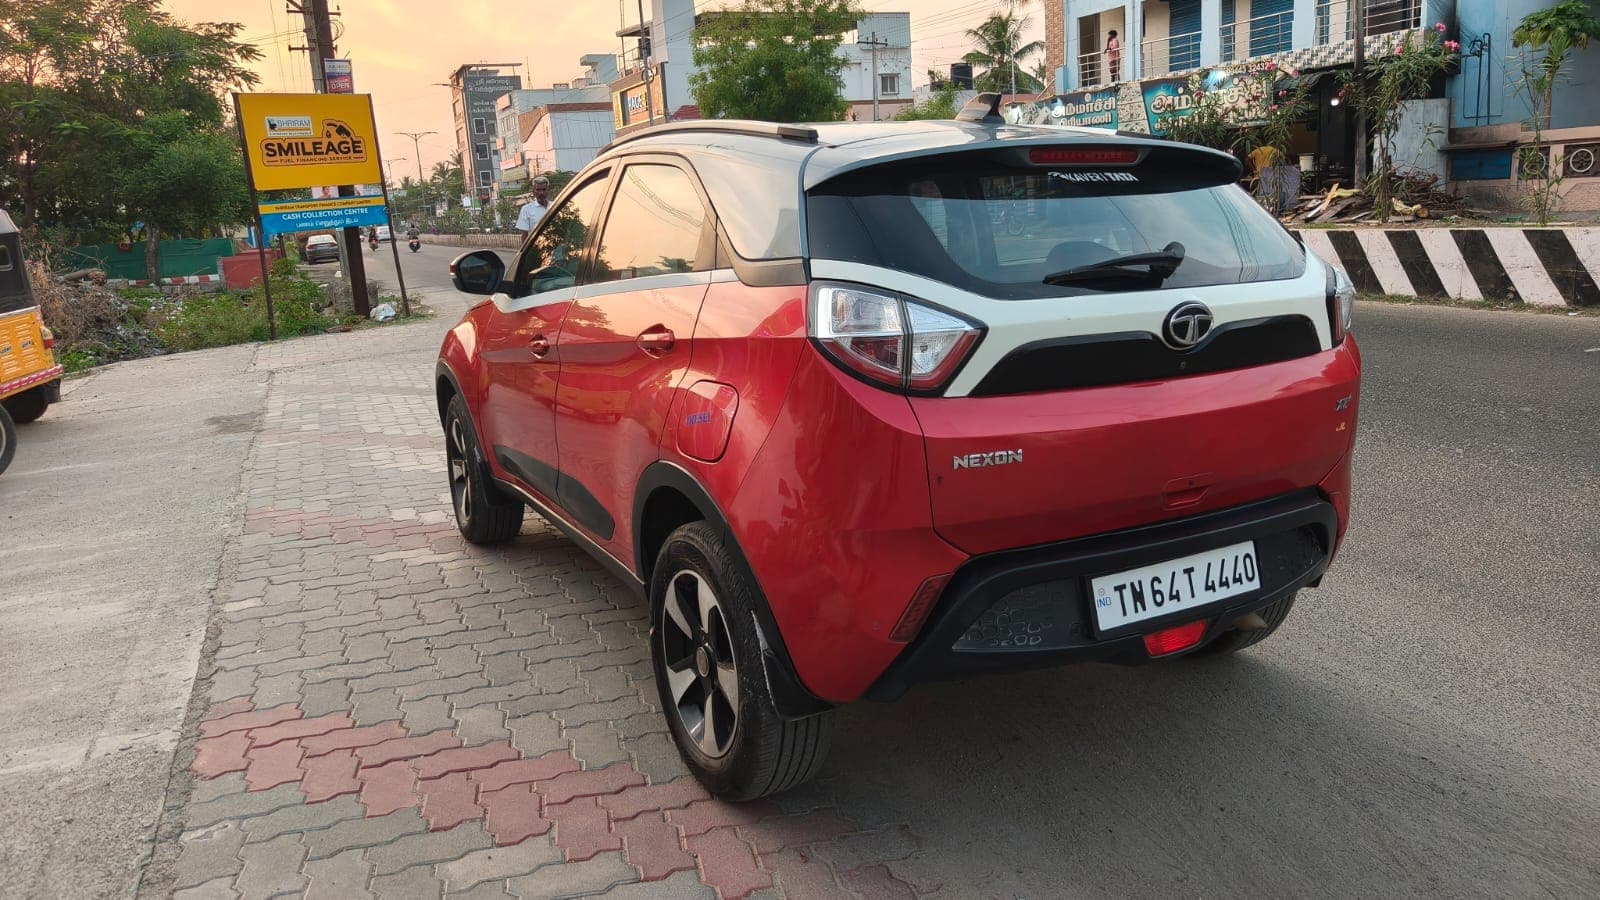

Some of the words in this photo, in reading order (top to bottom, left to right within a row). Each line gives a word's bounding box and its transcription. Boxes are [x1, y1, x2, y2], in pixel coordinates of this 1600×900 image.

[278, 119, 311, 128] SHRIRAM
[265, 140, 363, 157] SMILEAGE
[1104, 172, 1139, 181] TATA
[302, 209, 343, 219] COLLECTION
[344, 207, 369, 215] CENTRE
[953, 449, 1023, 470] NEXON
[1096, 596, 1112, 608] IND
[1204, 552, 1256, 593] 4440
